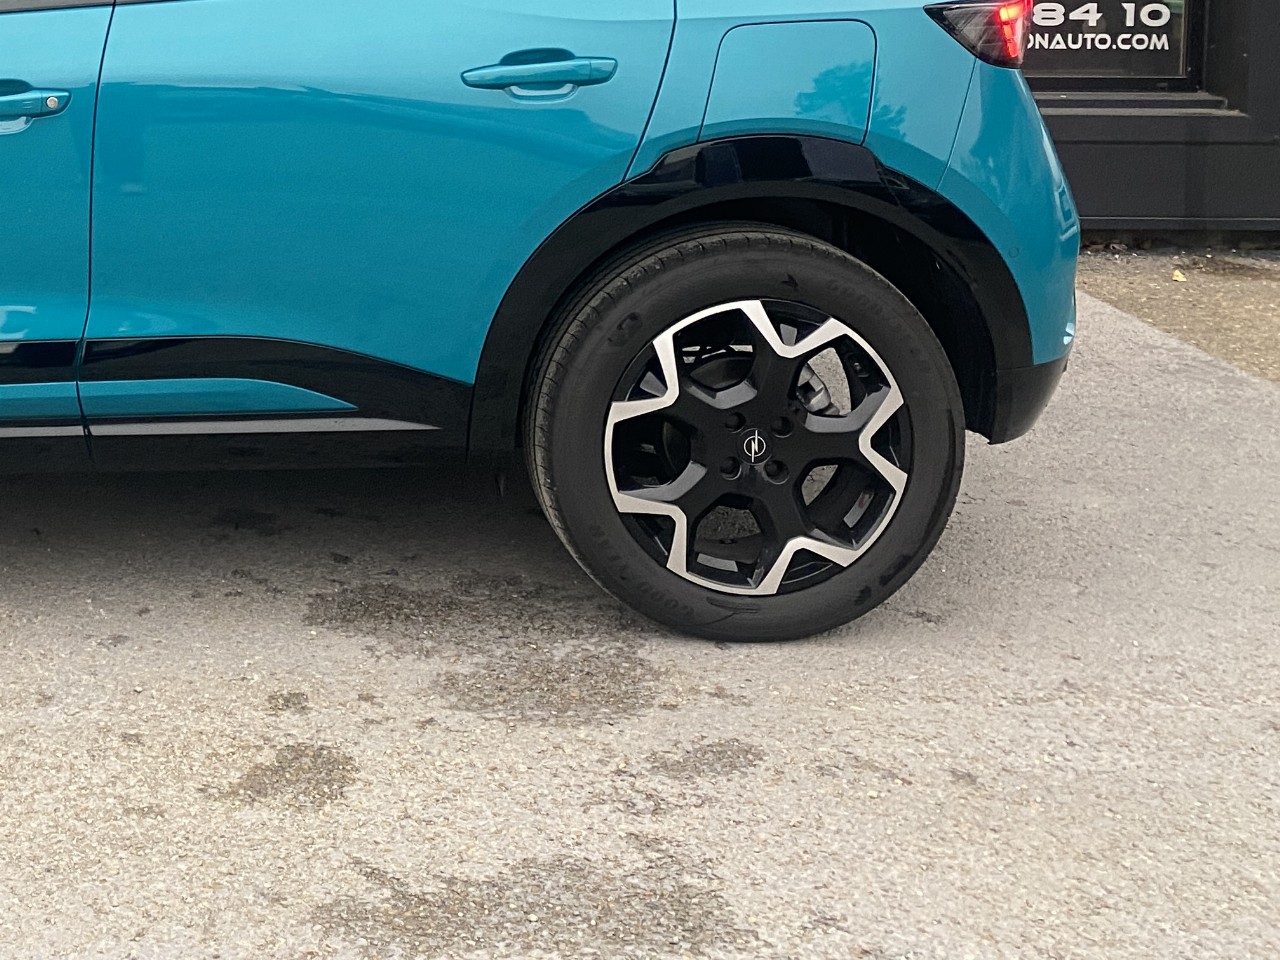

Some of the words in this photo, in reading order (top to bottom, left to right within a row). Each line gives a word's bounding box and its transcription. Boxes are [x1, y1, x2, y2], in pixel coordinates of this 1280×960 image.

[1032, 2, 1103, 27] 84
[1121, 2, 1171, 27] 10
[1027, 33, 1169, 50] NAUTO.COM
